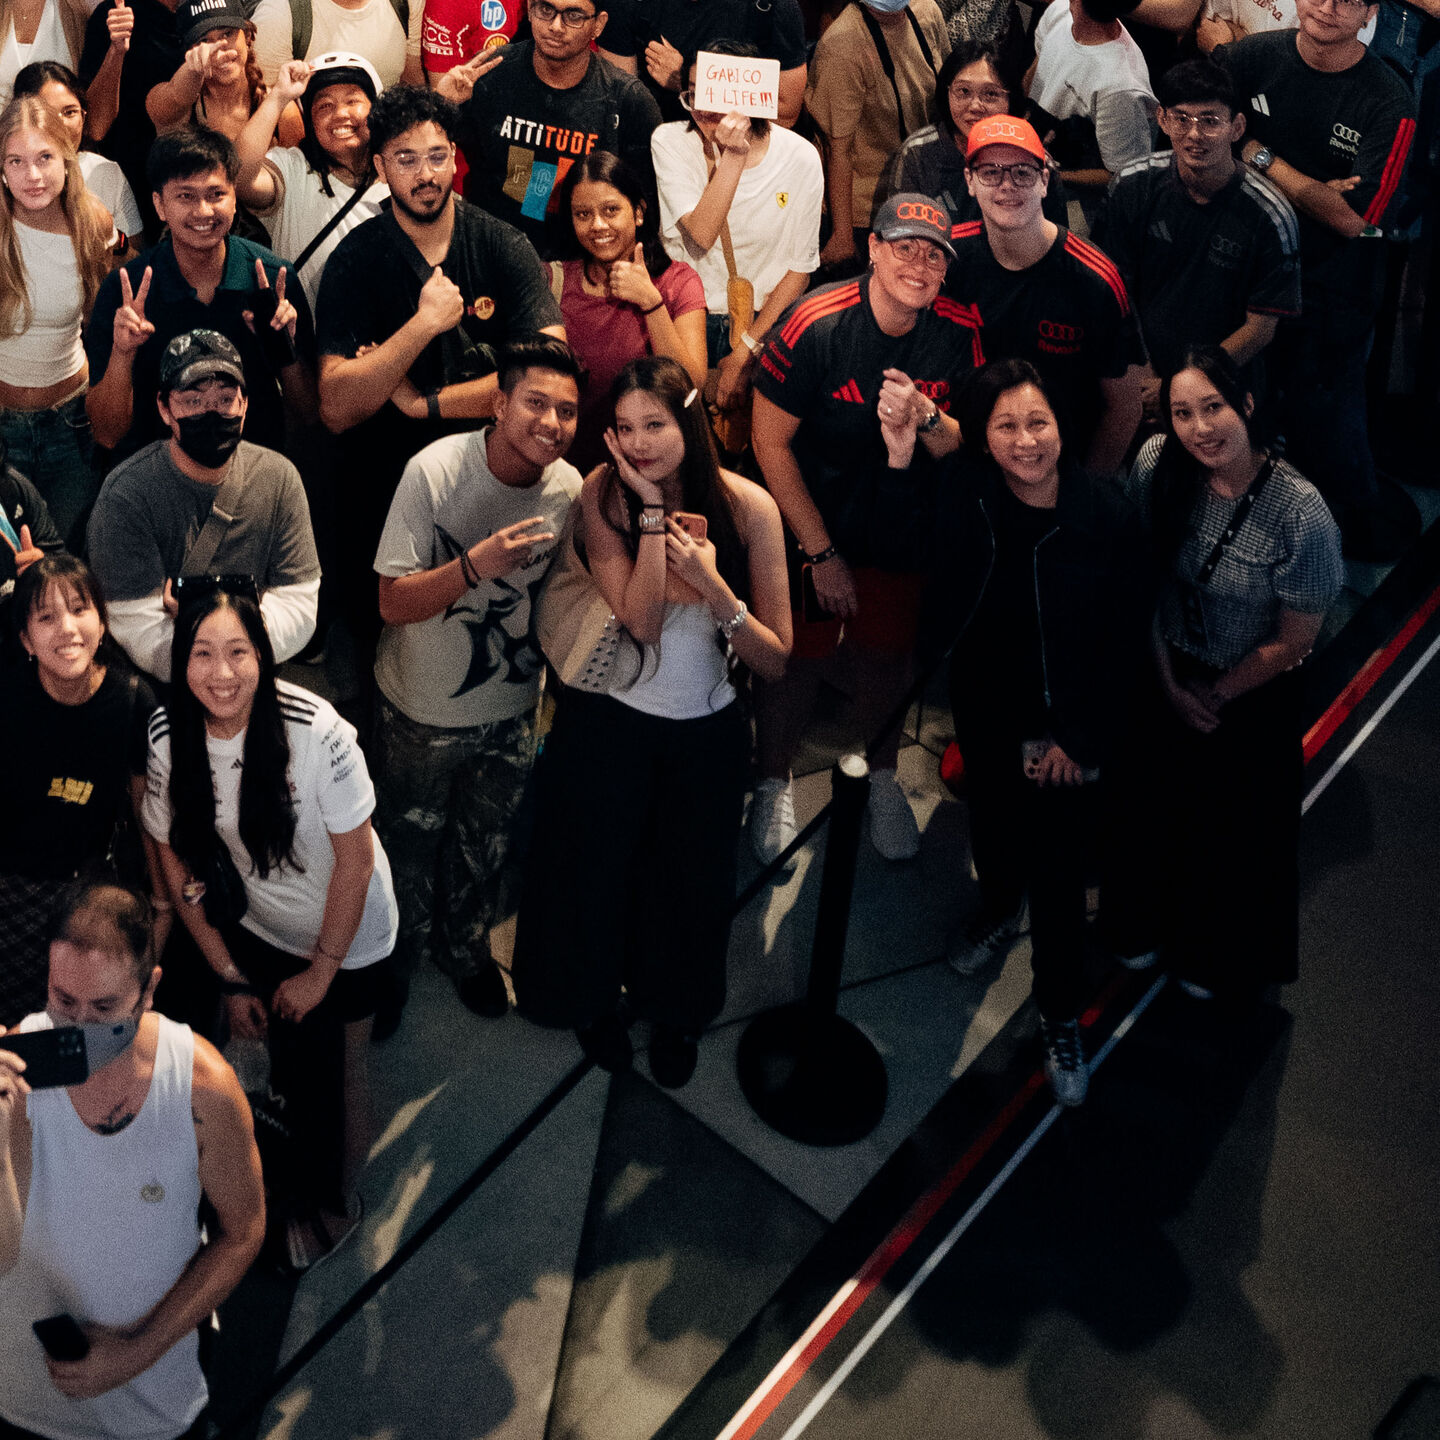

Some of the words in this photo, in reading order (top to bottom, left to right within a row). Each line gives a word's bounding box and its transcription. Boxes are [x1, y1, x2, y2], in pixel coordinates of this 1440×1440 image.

[482, 2, 505, 30] hp
[705, 86, 714, 104] 4
[500, 115, 599, 155] ATTITUDE
